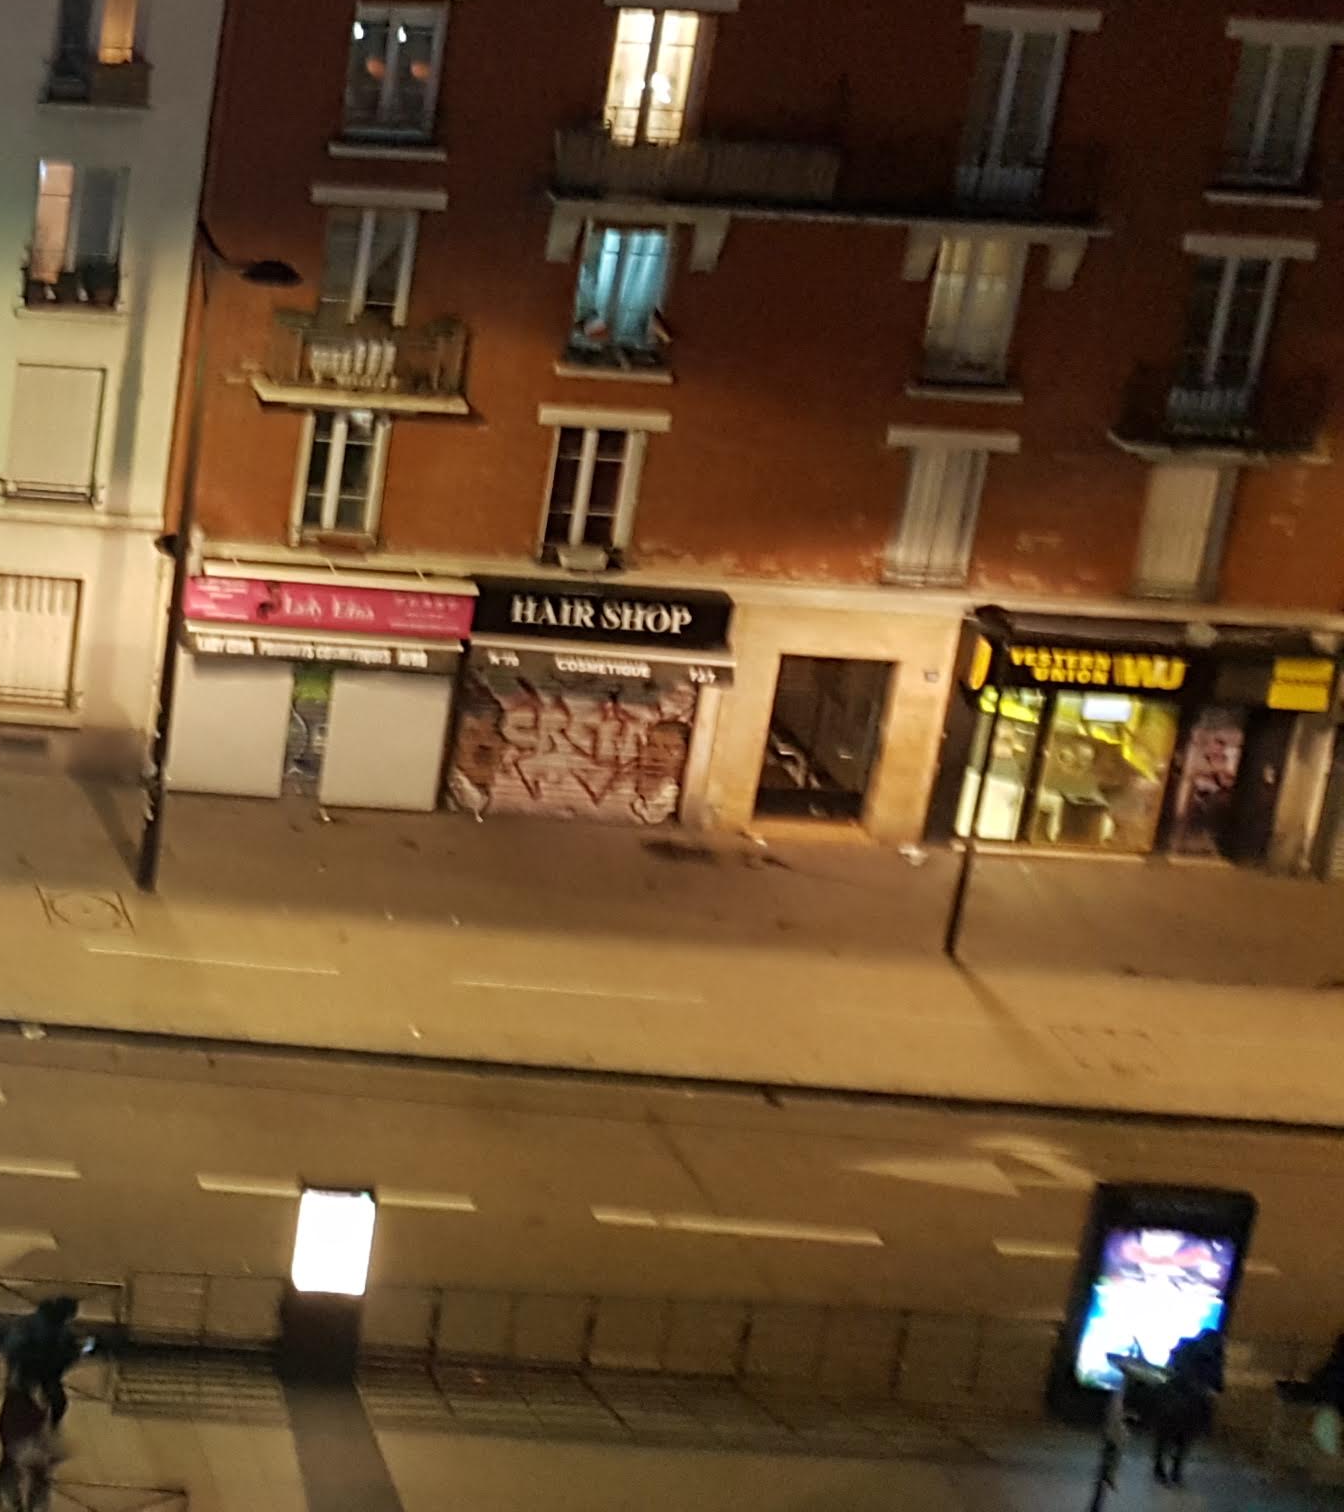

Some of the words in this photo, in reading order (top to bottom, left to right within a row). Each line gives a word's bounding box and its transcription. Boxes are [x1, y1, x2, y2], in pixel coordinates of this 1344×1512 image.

[511, 594, 595, 628] HAIR
[601, 600, 692, 634] SHOP
[555, 655, 651, 678] COSMETIQUE
[1032, 667, 1109, 685] UNION
